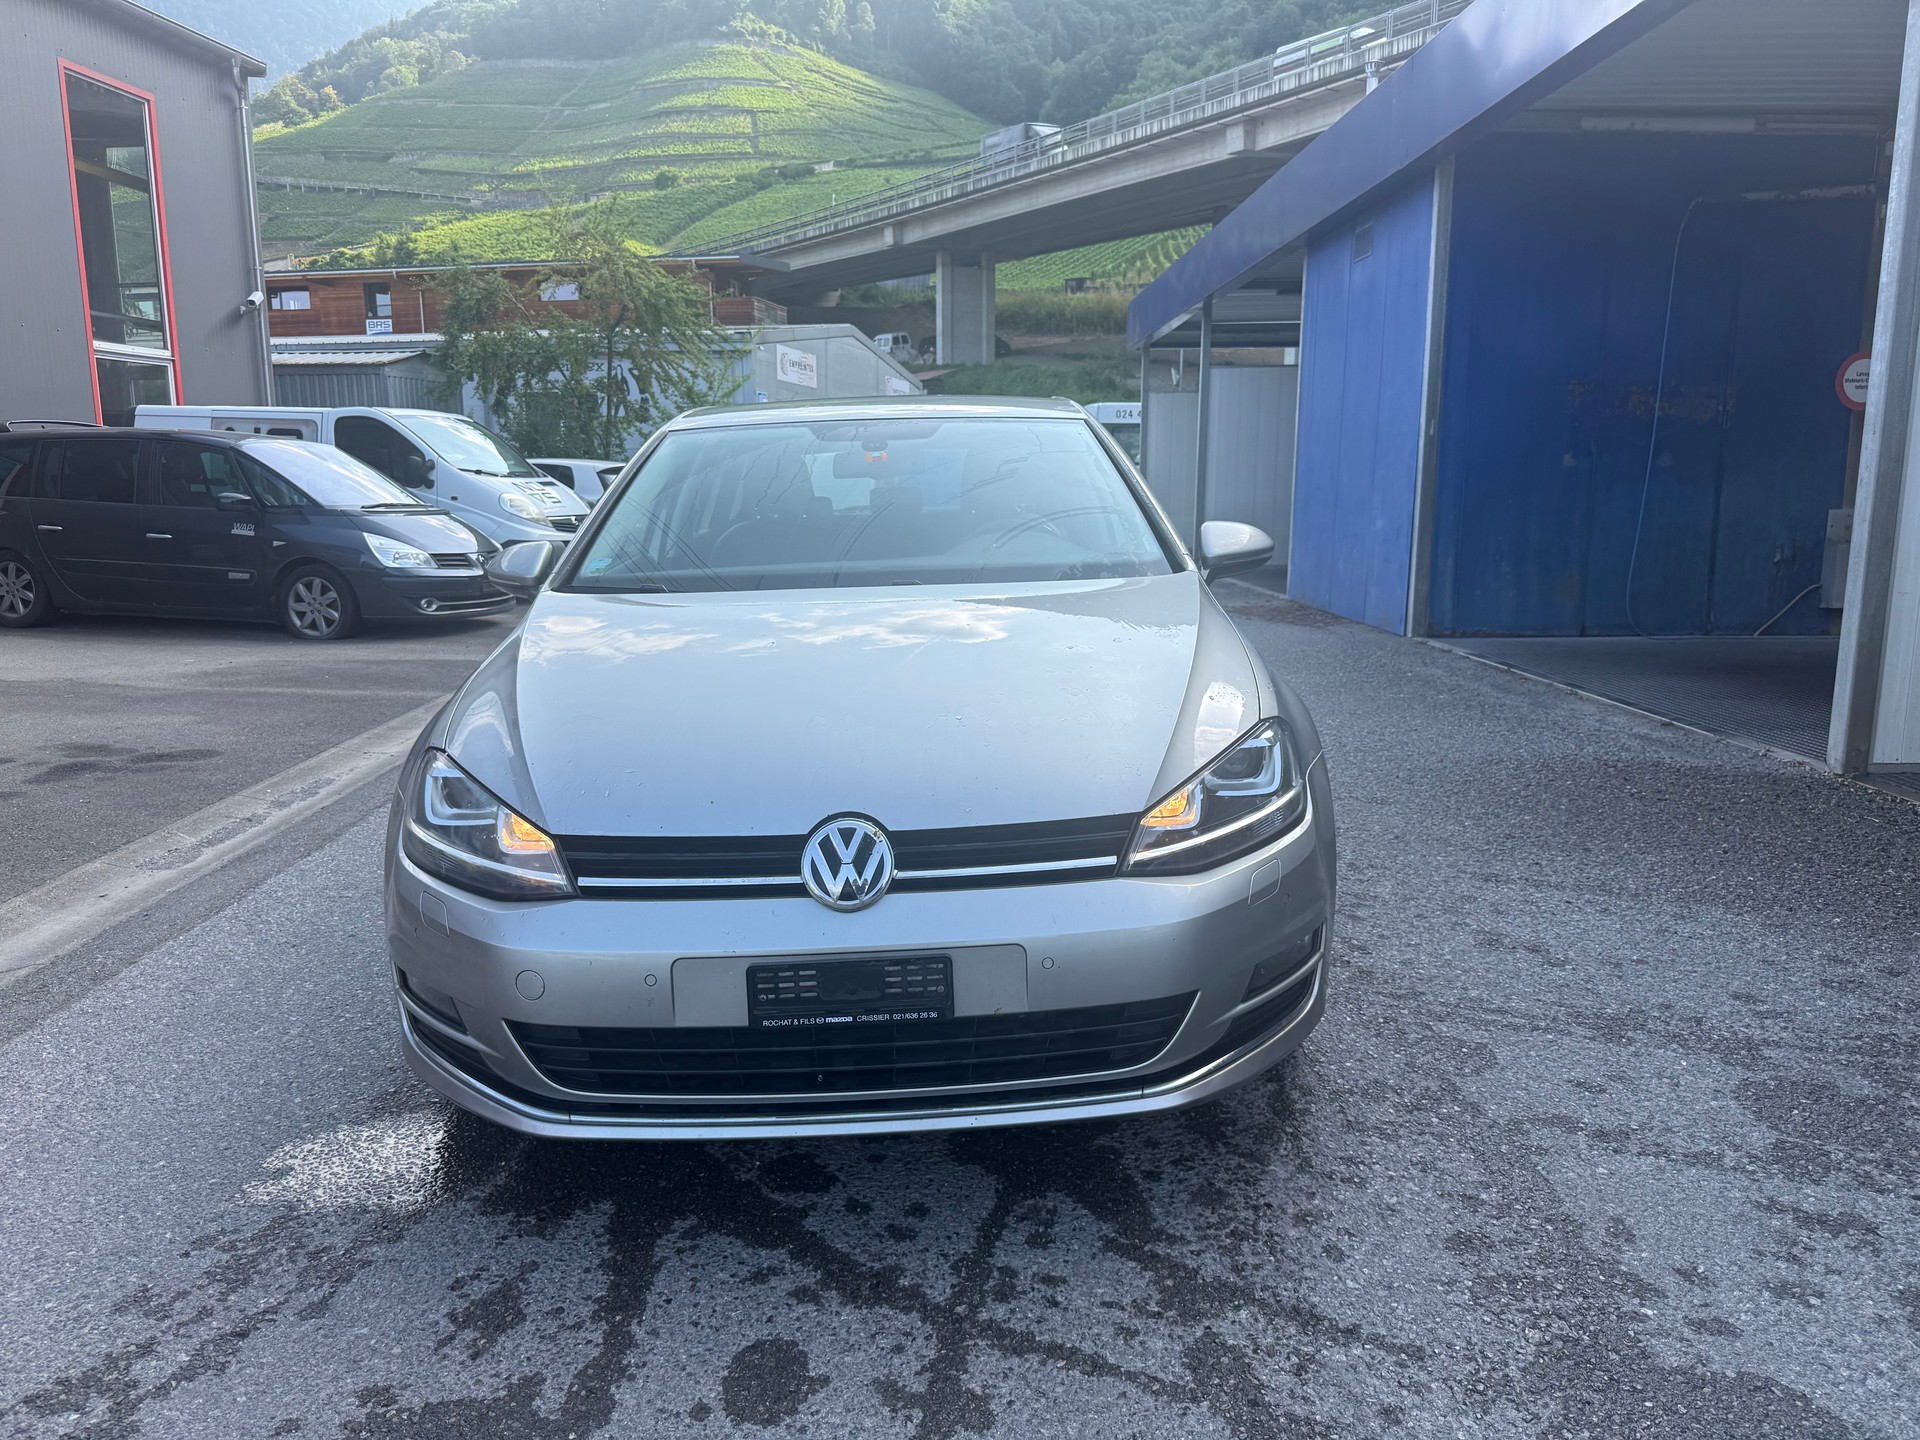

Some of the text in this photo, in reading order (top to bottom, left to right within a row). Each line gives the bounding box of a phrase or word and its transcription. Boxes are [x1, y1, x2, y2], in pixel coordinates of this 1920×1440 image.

[368, 321, 390, 329] BRS
[1115, 410, 1133, 419] 024
[762, 1019, 792, 1027] ROCHAT
[793, 1018, 799, 1026] &
[800, 1017, 815, 1025] FILS
[856, 1014, 890, 1022] CRISSIER
[929, 1011, 938, 1019] 36
